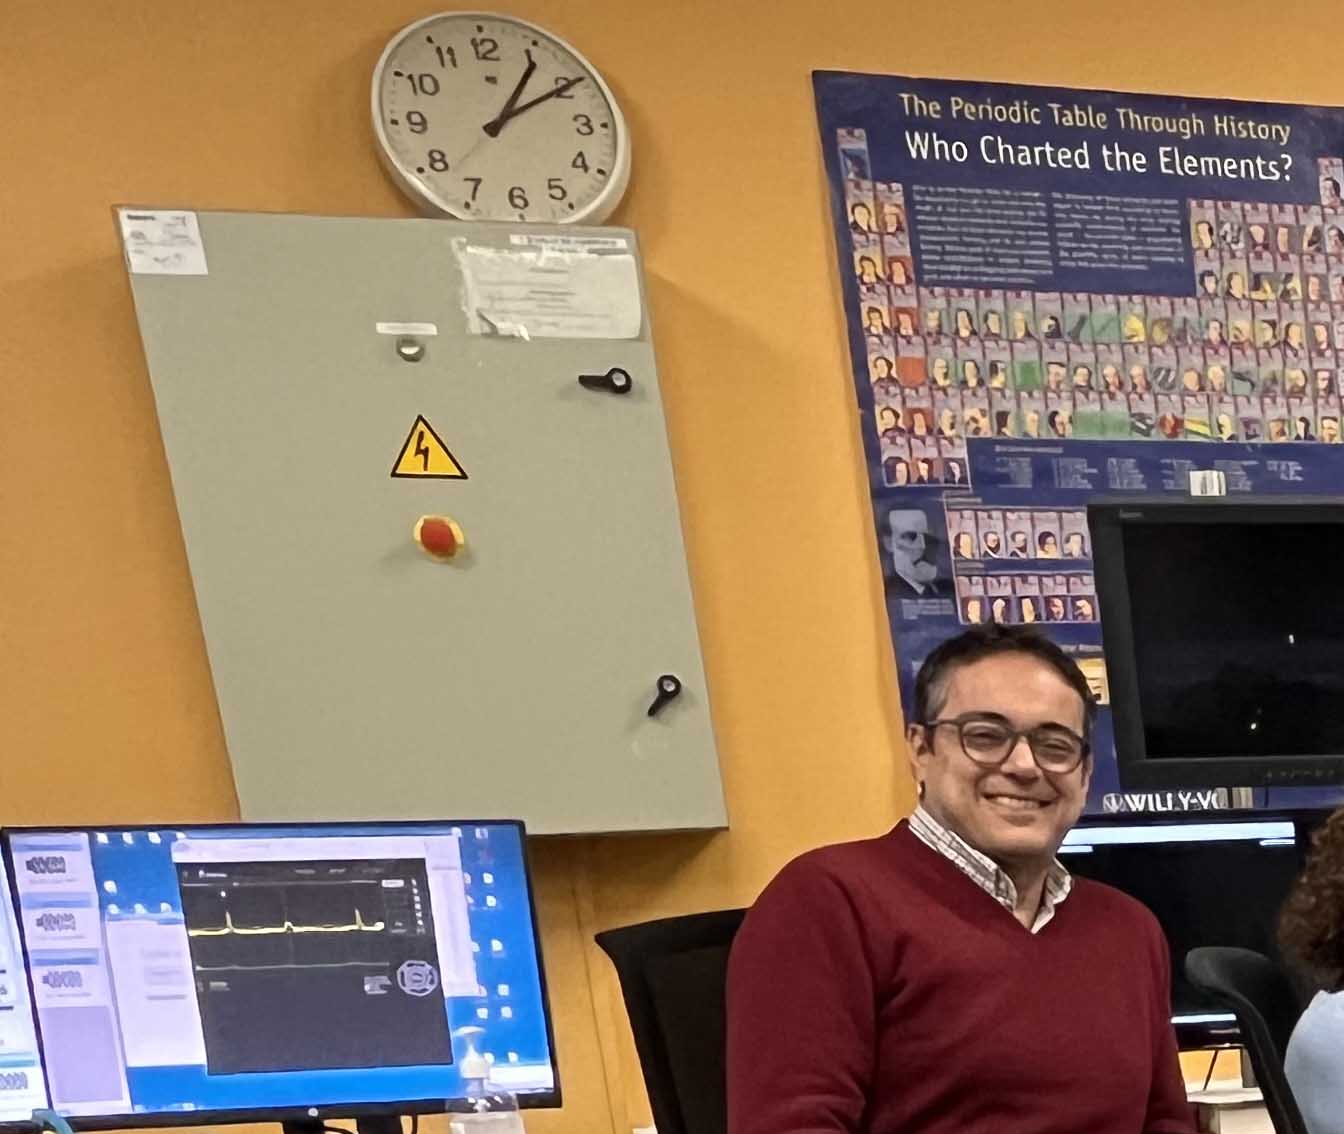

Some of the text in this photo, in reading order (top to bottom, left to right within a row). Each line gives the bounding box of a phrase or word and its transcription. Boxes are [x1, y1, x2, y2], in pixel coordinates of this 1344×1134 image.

[435, 46, 458, 68] 11
[471, 37, 500, 61] 12
[406, 73, 440, 96] 10
[554, 76, 575, 98] 2
[406, 111, 428, 134] 9
[572, 114, 594, 136] 3
[898, 93, 1291, 146] The Periodic Table Through History
[427, 149, 449, 172] 8
[571, 150, 589, 173] 4
[904, 130, 1293, 182] Who Charted the Elements?
[463, 177, 483, 201] 7
[507, 186, 529, 210] 6
[547, 178, 567, 201] 5
